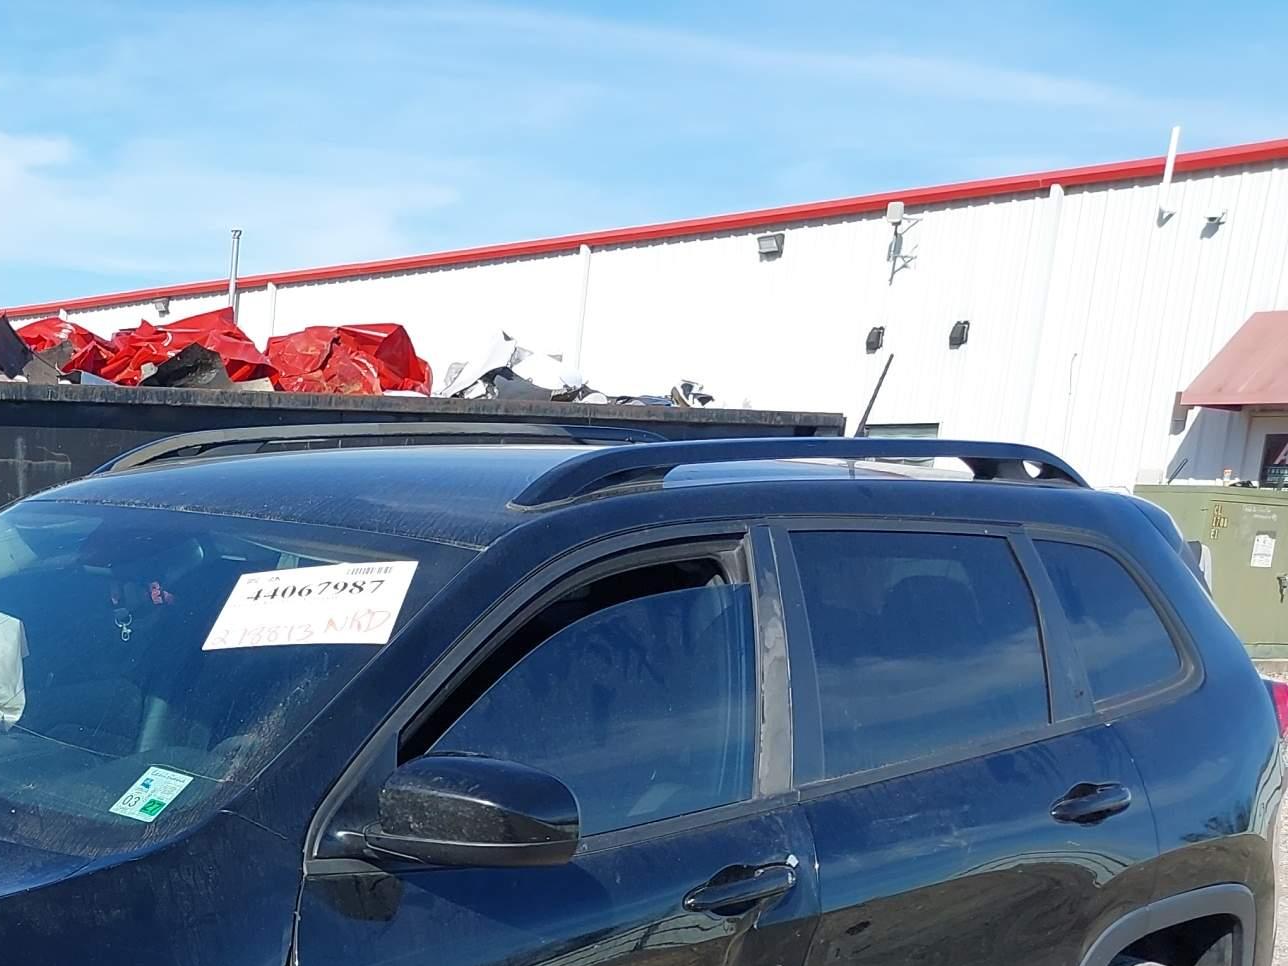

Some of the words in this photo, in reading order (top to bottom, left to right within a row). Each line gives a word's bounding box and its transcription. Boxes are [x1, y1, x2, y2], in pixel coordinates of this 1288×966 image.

[246, 579, 385, 601] 44067987
[121, 794, 141, 808] 03
[141, 798, 165, 814] 27
